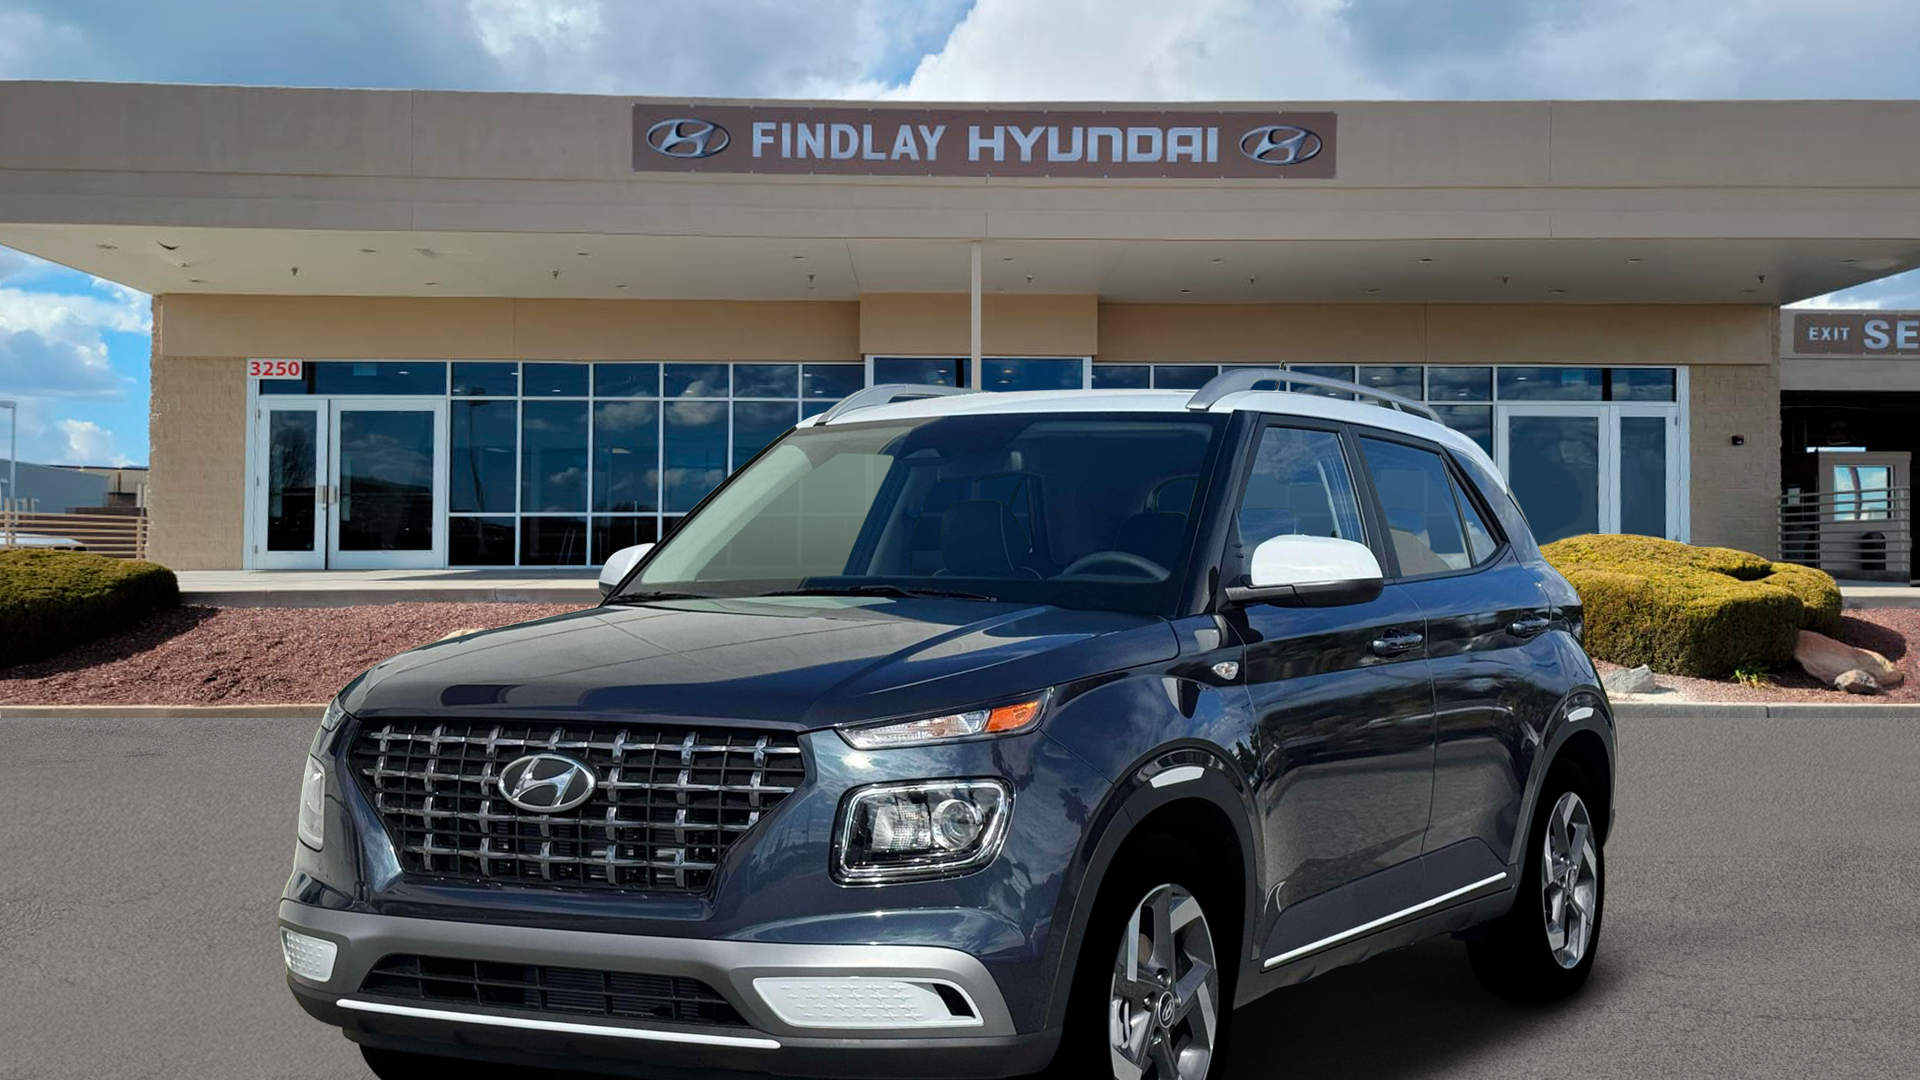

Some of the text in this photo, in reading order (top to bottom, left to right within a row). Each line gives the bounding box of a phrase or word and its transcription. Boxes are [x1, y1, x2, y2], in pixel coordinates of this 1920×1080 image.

[752, 121, 1219, 163] FINDLAY HYUNDAI
[1808, 319, 1919, 349] EXIT SE
[249, 360, 300, 377] 3250
